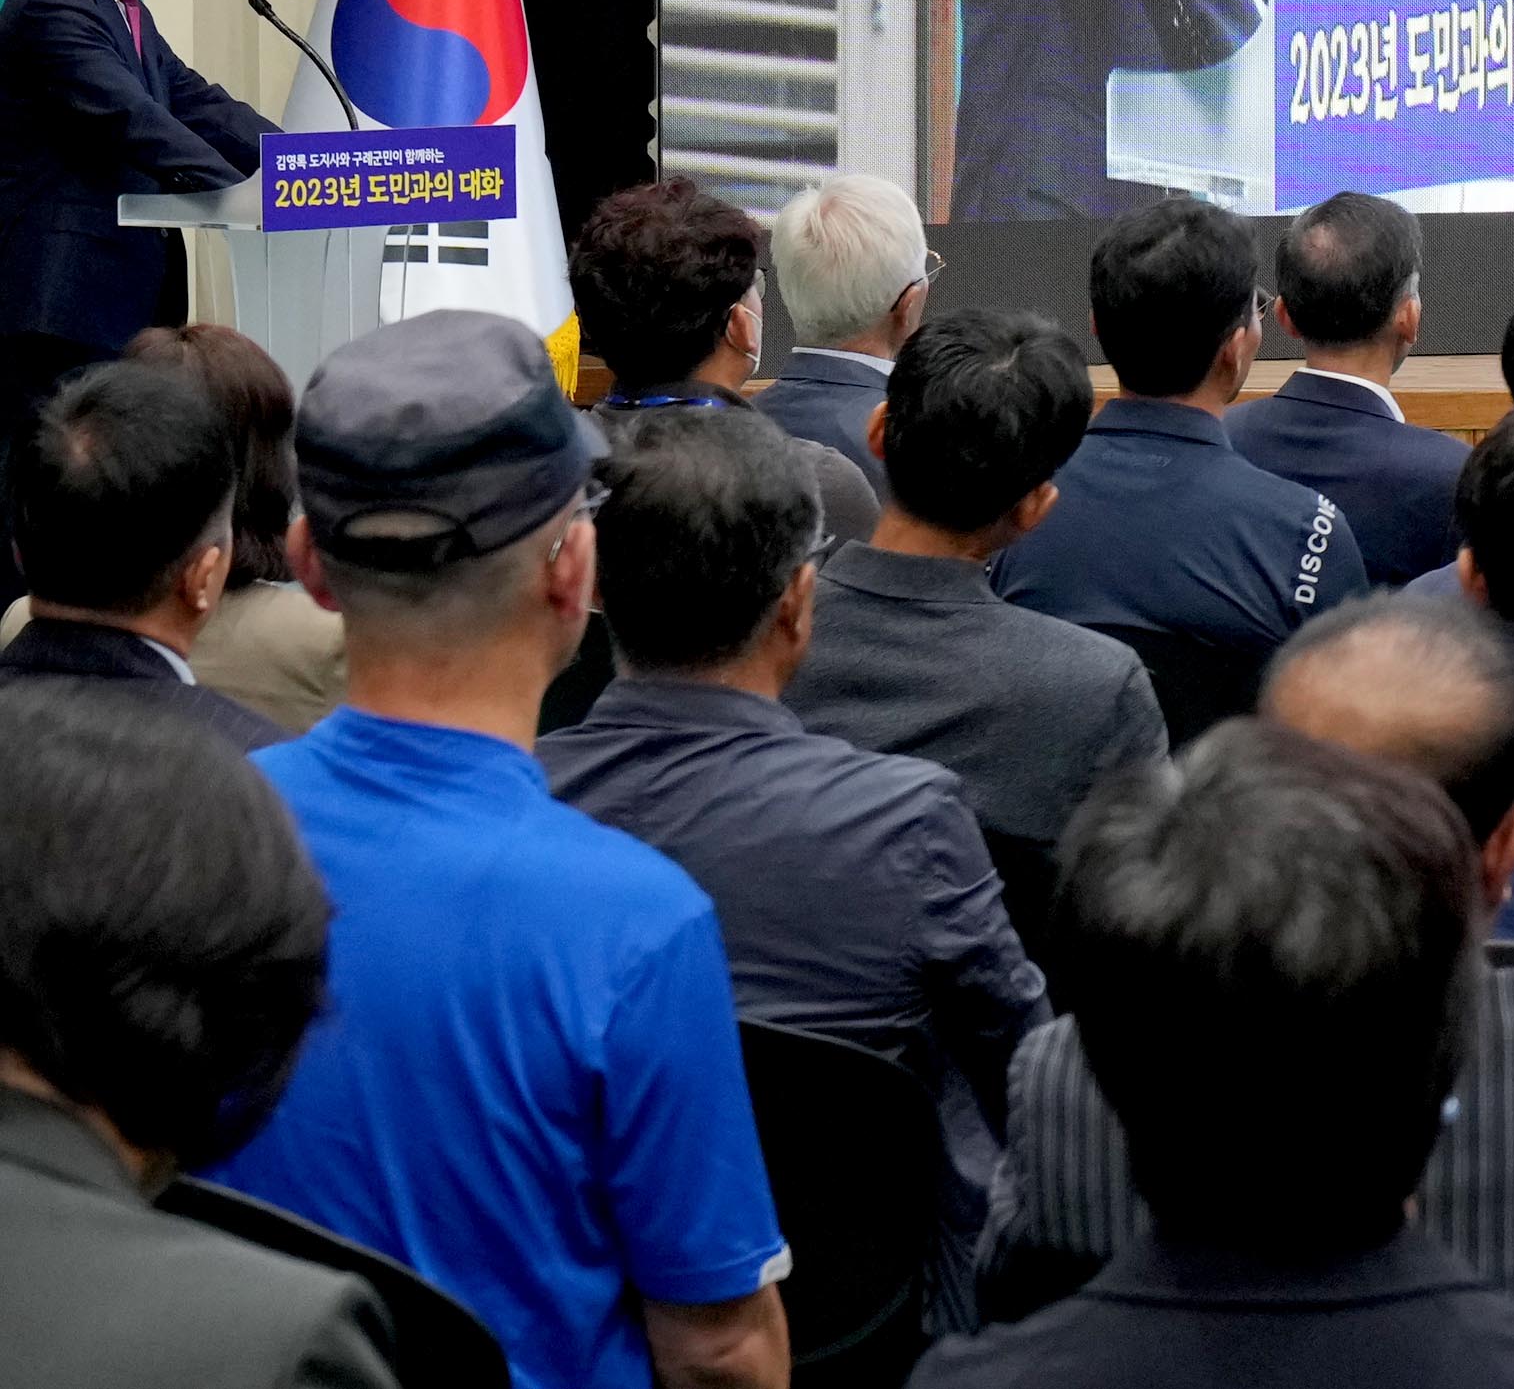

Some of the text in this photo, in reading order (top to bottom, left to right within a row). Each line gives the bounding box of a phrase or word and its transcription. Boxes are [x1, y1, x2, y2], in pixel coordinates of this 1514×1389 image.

[1289, 10, 1399, 124] 2023년
[309, 151, 351, 169] 도지사와
[352, 149, 403, 168] 구례군민이
[404, 147, 445, 165] 함께하는
[275, 167, 504, 208] 2023년 도민과의 대화
